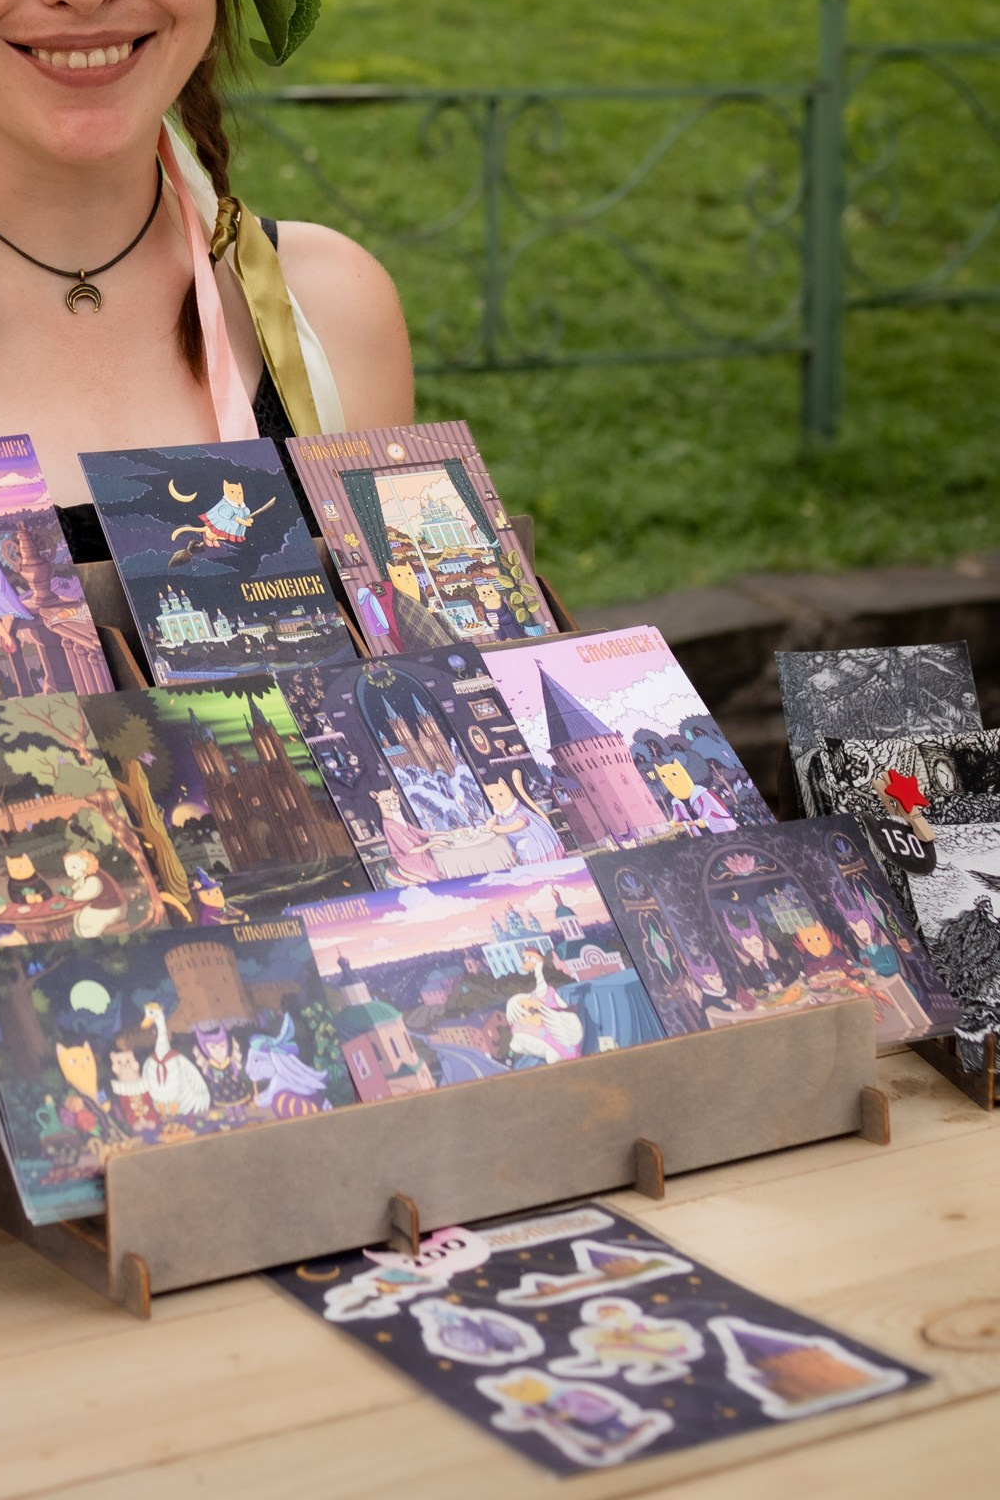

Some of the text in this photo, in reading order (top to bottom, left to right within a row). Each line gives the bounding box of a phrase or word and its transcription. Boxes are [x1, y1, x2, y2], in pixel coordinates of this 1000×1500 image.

[300, 439, 371, 461] СМОЛЕНСК
[240, 575, 325, 602] СМОЛЕНСК
[576, 633, 657, 663] СМОЛЕНСК
[881, 829, 925, 858] 150
[291, 897, 371, 928] МОЛЕНСК
[233, 920, 303, 943] СМОЛЕНСК
